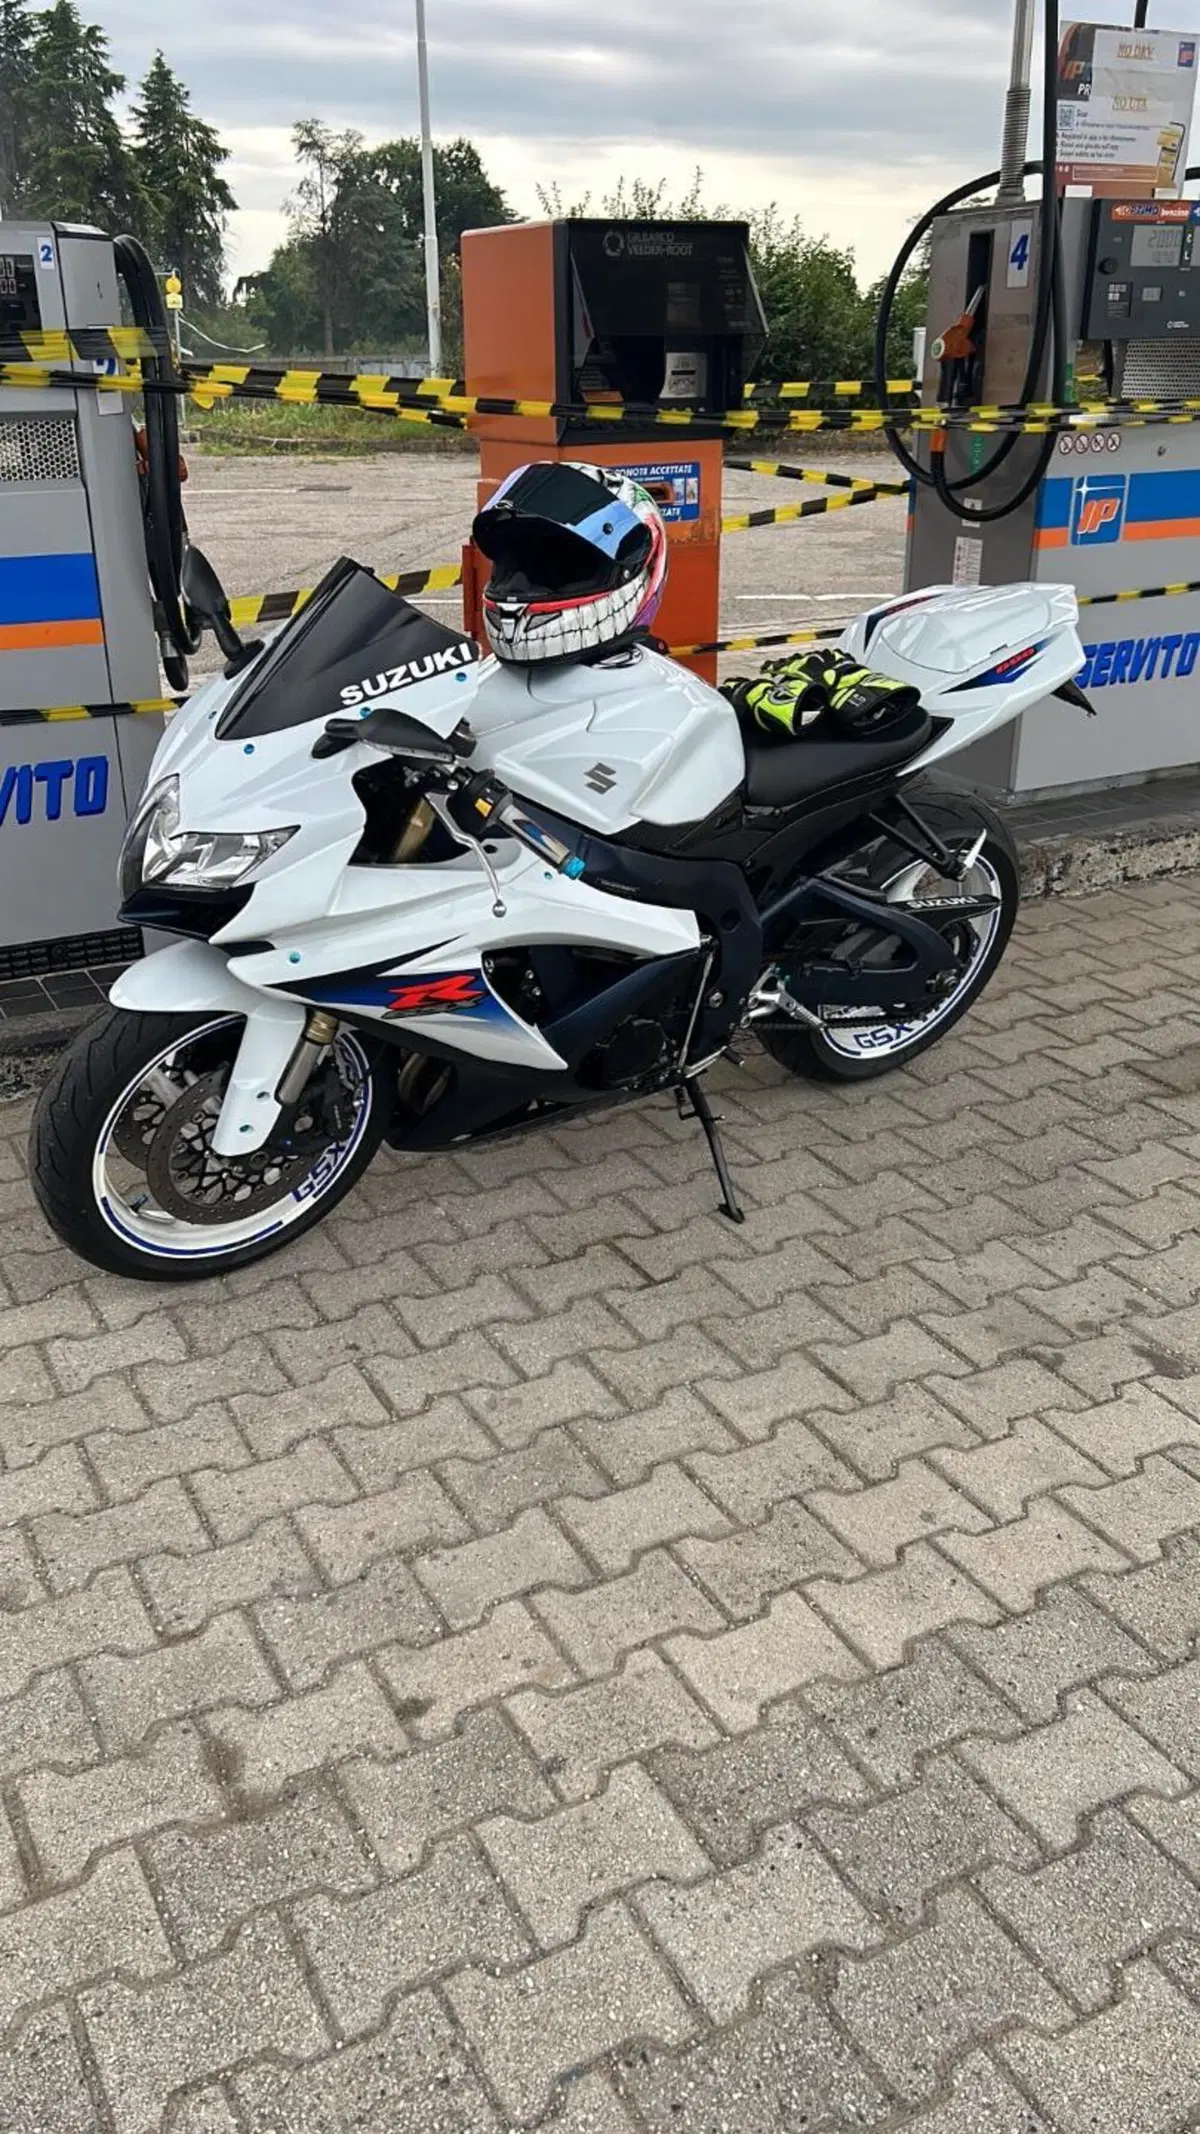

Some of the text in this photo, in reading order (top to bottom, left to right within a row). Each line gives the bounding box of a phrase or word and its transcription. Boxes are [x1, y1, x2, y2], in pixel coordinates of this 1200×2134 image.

[40, 244, 53, 262] 2
[1010, 234, 1029, 271] 4
[1077, 498, 1121, 535] IP
[340, 642, 473, 706] SUZUKI
[1073, 632, 1200, 690] SERVITO
[906, 896, 979, 909] SUZUKI
[852, 1023, 915, 1049] GSX
[291, 1143, 347, 1203] GSX
